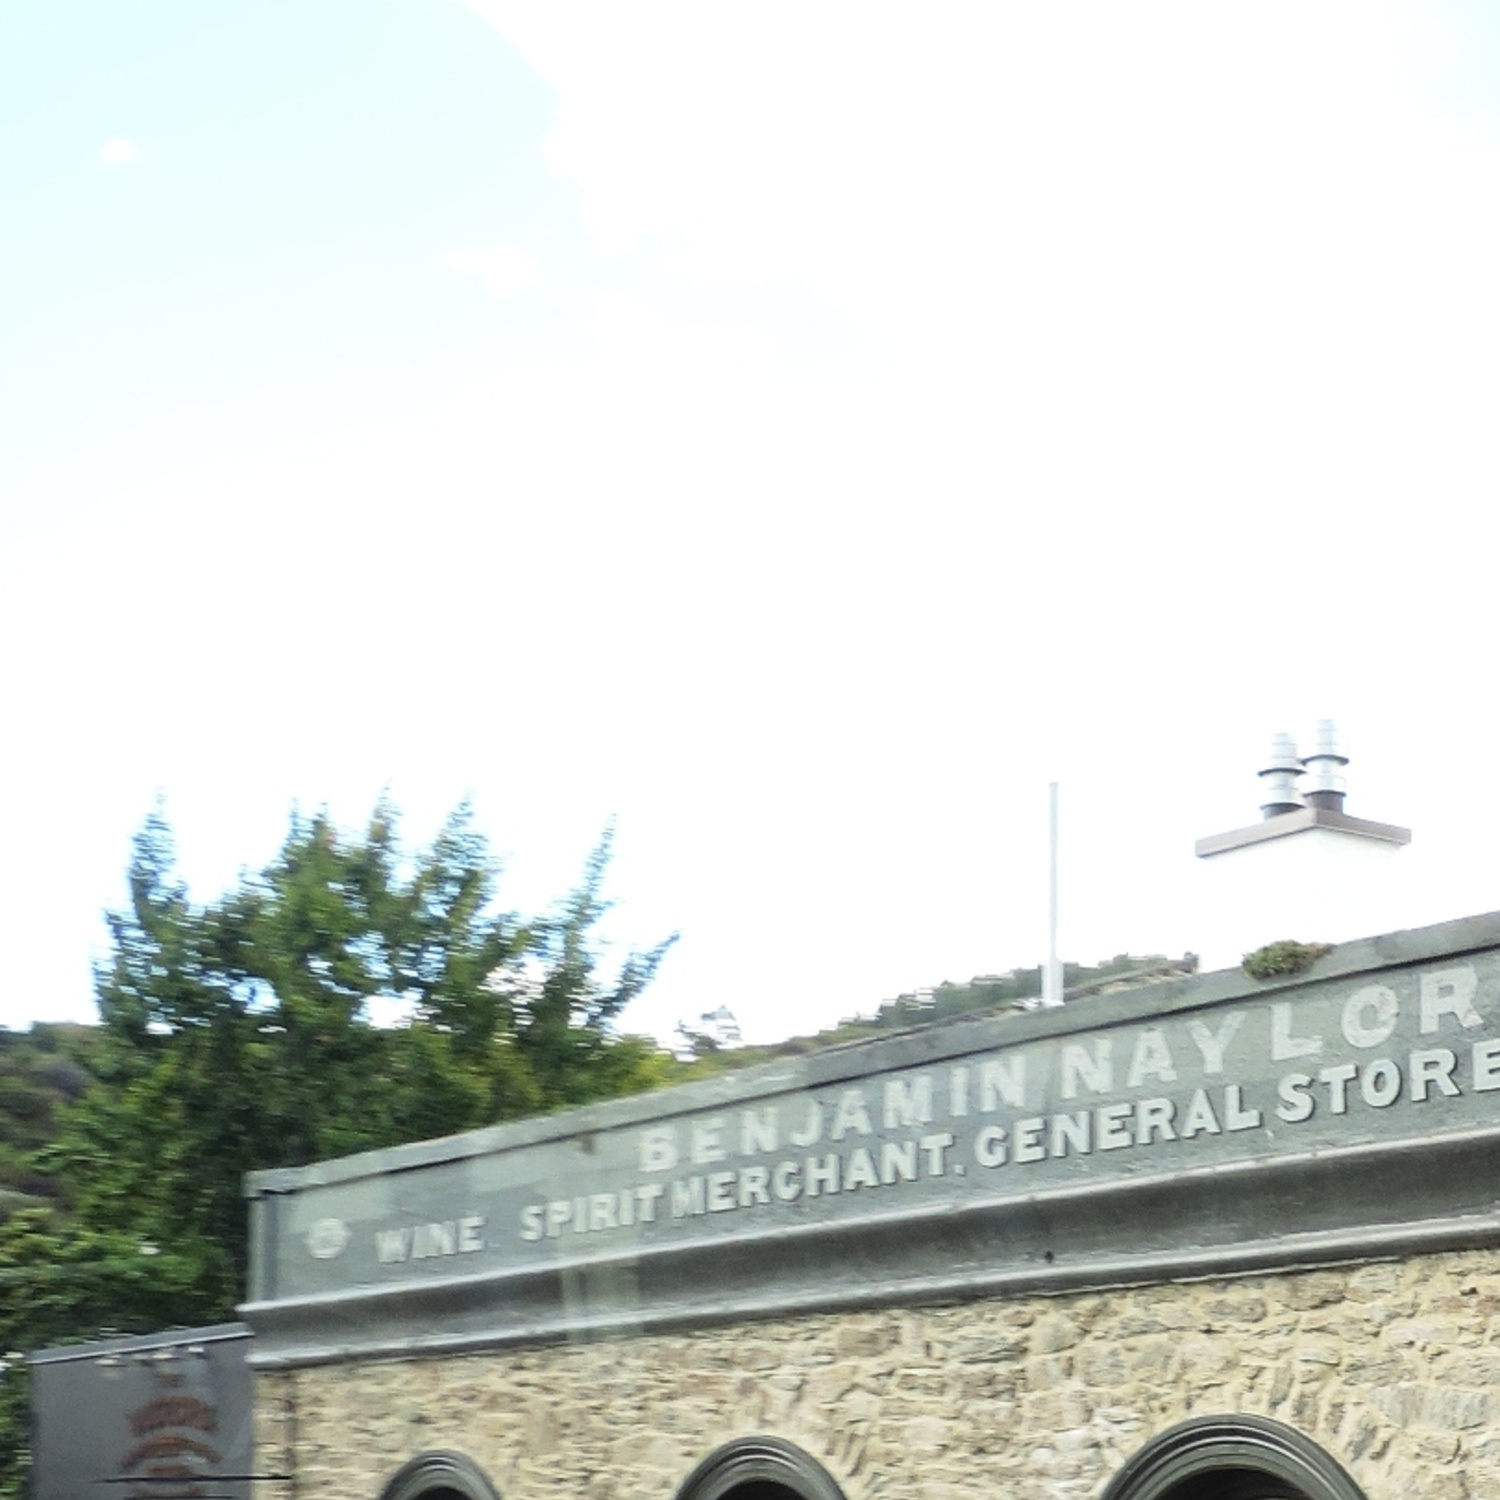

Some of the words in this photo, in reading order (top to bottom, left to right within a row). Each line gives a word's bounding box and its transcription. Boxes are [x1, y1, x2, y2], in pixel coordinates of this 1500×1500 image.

[638, 1055, 1027, 1173] BENJAMIN
[1060, 965, 1484, 1099] NAYLOR
[375, 1215, 485, 1263] WINE
[520, 1183, 662, 1242] SPIRIT
[974, 1085, 1262, 1168] GENERAL
